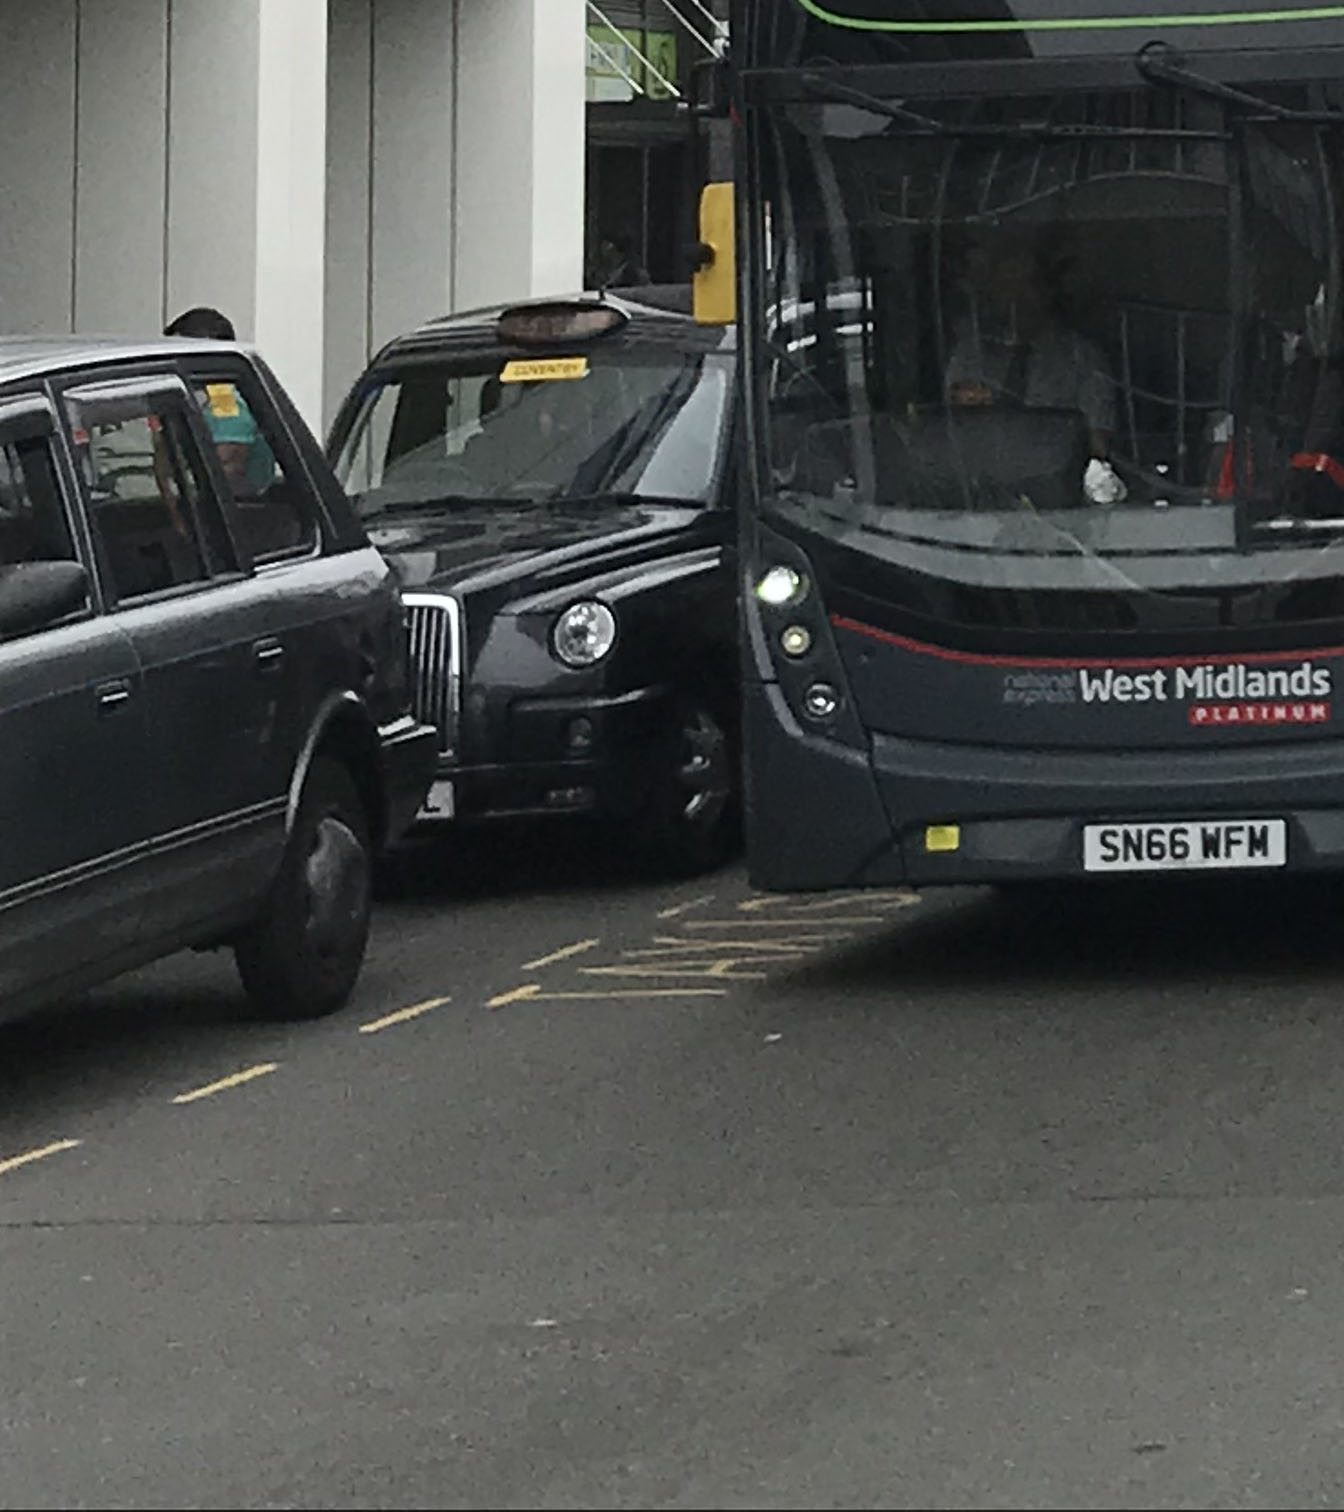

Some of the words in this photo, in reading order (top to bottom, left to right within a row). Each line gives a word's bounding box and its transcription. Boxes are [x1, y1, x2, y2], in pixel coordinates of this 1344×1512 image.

[1079, 668, 1167, 702] West
[1176, 662, 1331, 699] Midlands
[1195, 704, 1327, 722] PLATINUM
[1100, 827, 1190, 863] SN66
[1201, 825, 1269, 859] WFM
